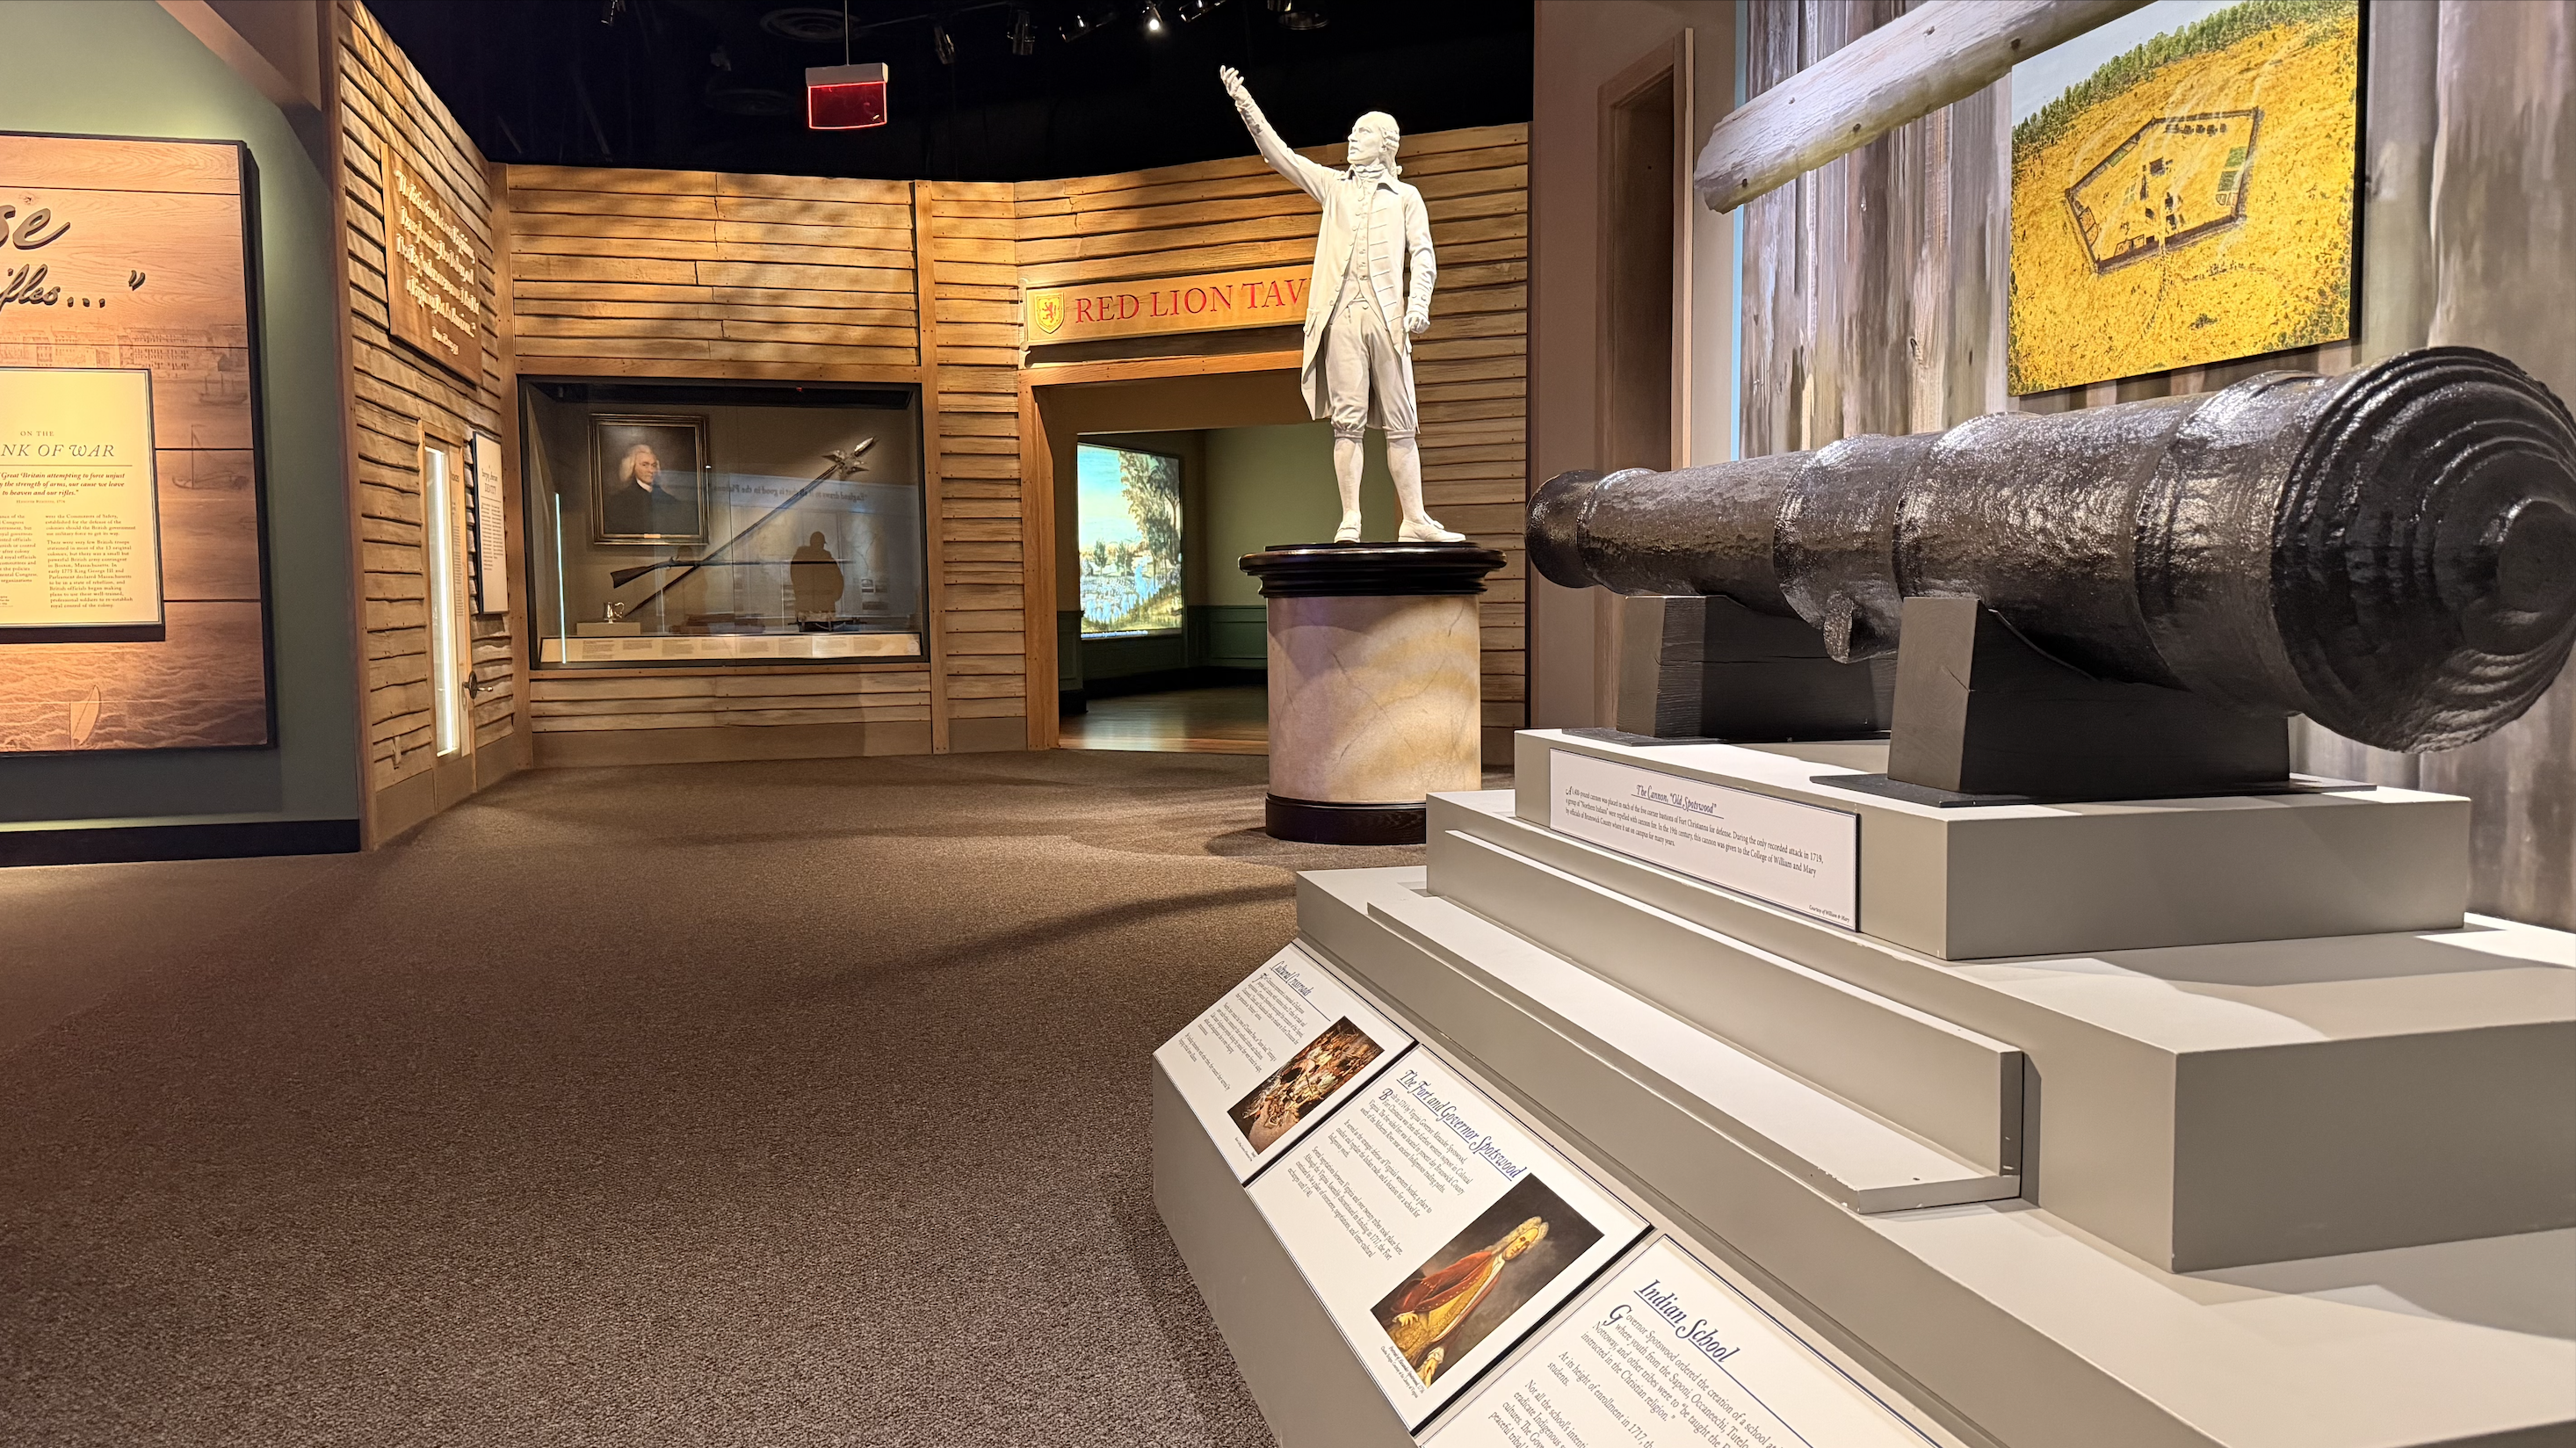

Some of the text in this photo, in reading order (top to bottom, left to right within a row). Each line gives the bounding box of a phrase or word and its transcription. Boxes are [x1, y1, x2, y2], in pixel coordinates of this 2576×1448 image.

[1075, 277, 1312, 323] RED LION TAV
[38, 444, 65, 457] OF
[69, 445, 115, 458] WAR
[15, 481, 42, 489] strength
[42, 481, 50, 489] of
[105, 472, 126, 481] unjust
[1636, 784, 1647, 797] The
[1646, 785, 1668, 803] Cannon,
[1607, 797, 1618, 807] placed
[1646, 809, 1659, 818] corner
[1658, 810, 1674, 822] bastions
[1678, 815, 1687, 826] Fort
[1687, 818, 1709, 832] Christanna
[1715, 826, 1733, 838] defense.
[1733, 830, 1749, 845] During
[1756, 837, 1768, 851] only
[1767, 842, 1788, 854] recorded
[1788, 847, 1803, 858] attack
[1803, 850, 1809, 860] in
[1810, 851, 1824, 865] 1719,
[1616, 812, 1630, 822] repelled
[1637, 818, 1651, 828] cannon
[1657, 822, 1662, 831] In
[1669, 826, 1678, 836] 19th
[1677, 829, 1694, 842] century,
[1693, 832, 1702, 843] this
[1701, 836, 1717, 847] cannon
[1725, 843, 1737, 852] given
[1749, 848, 1768, 863] College
[1767, 853, 1774, 863] of
[1773, 855, 1792, 869] William
[1792, 862, 1802, 872] and
[1802, 863, 1817, 878] Mary
[1270, 959, 1314, 996] Cultural Crossroads
[1399, 1068, 1528, 1178] The Fort and Governor Spotswood
[1638, 1278, 1740, 1363] Indian School
[1546, 1362, 1569, 1386] students.
[1580, 1330, 1610, 1359] instructed
[1603, 1354, 1613, 1365] in
[1610, 1362, 1623, 1374] the
[1620, 1369, 1647, 1399] Christian
[1591, 1320, 1619, 1351] Nottoway,
[1616, 1346, 1632, 1359] and
[1626, 1357, 1644, 1373] other
[1640, 1370, 1660, 1388] tribes
[1656, 1385, 1673, 1401] were
[1669, 1398, 1680, 1408] to
[1687, 1415, 1711, 1437] taught
[1707, 1434, 1721, 1448] the
[1614, 1323, 1632, 1342] where
[1626, 1338, 1649, 1356] youth
[1644, 1350, 1661, 1369] from
[1658, 1365, 1671, 1378] the
[1668, 1372, 1694, 1400] Saponi,
[1690, 1393, 1729, 1434] Occaneechi,
[1645, 1329, 1680, 1362] Spotswood
[1674, 1359, 1702, 1382] ordered
[1696, 1378, 1710, 1392] the
[1706, 1389, 1733, 1415] creation
[1731, 1411, 1747, 1422] of
[1743, 1423, 1771, 1445] school
[1501, 1401, 1523, 1426] cultures.
[1520, 1419, 1532, 1436] The
[1513, 1392, 1562, 1447] eradicate Indigenous
[1524, 1379, 1538, 1395] Not
[1533, 1392, 1546, 1402] all
[1540, 1399, 1552, 1411] the
[1558, 1350, 1647, 1445] At its height of enrollment in 1717,
[1487, 1411, 1515, 1436] peaceful
